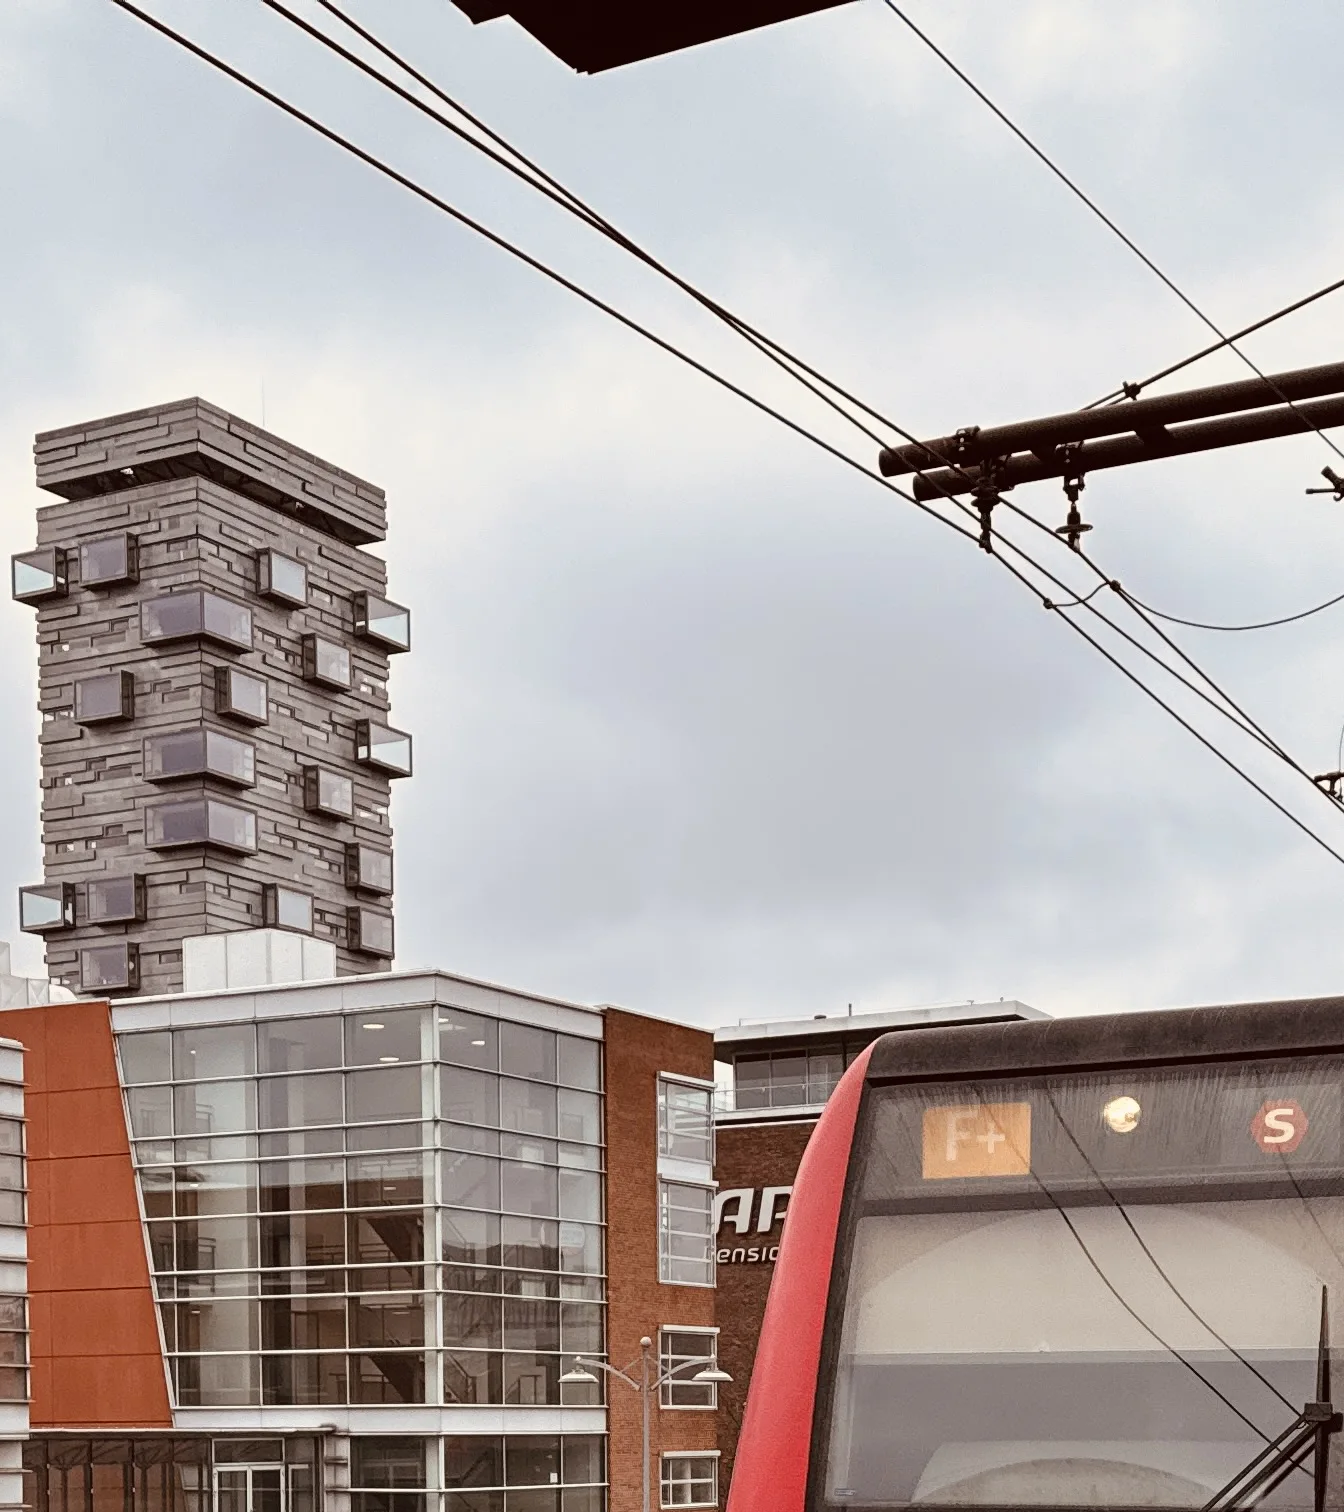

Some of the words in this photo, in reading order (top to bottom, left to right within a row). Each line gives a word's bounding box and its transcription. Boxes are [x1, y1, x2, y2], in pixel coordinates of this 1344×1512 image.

[945, 1107, 1005, 1161] F+
[1263, 1107, 1295, 1144] S
[717, 1246, 780, 1263] ensio
